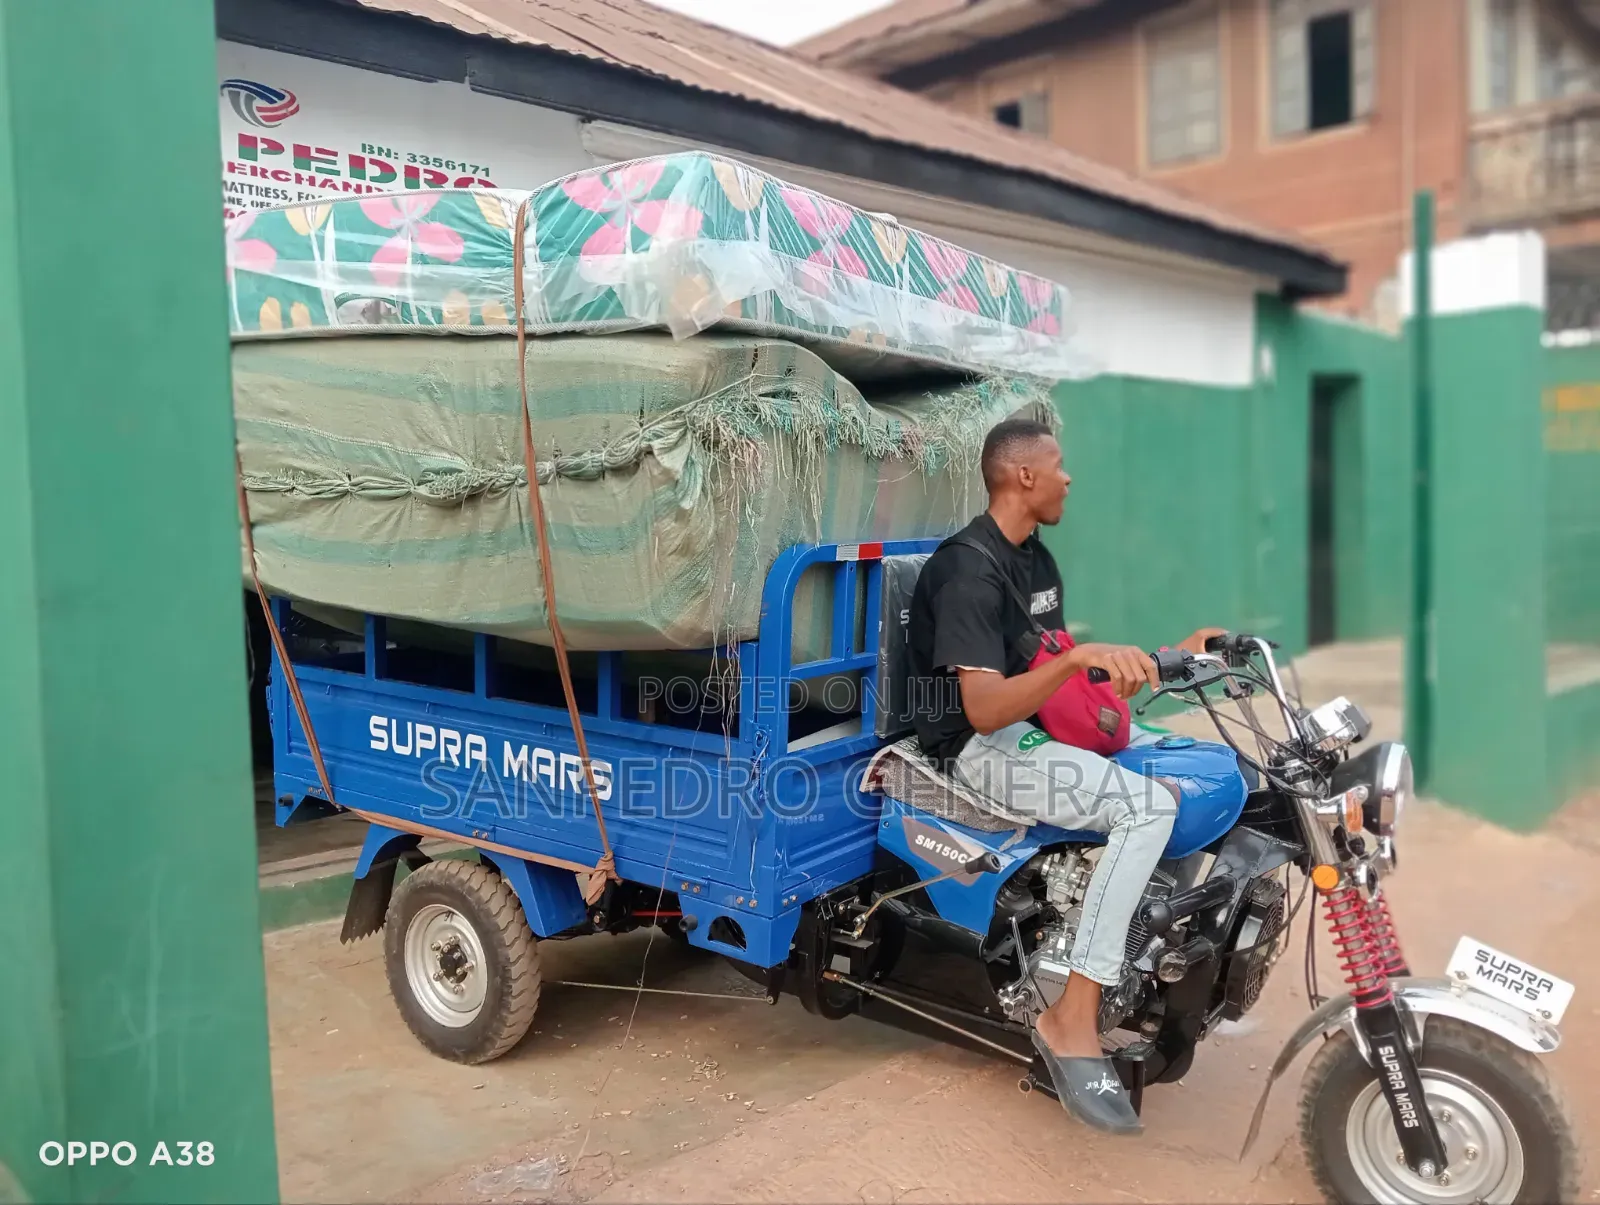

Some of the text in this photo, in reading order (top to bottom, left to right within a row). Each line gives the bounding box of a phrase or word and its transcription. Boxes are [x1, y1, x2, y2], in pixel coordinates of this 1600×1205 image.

[361, 142, 490, 178] BN: 3356171
[369, 715, 613, 801] SUPRA MARS
[1475, 949, 1554, 993] SUPRA
[1476, 964, 1540, 1001] MARS
[1378, 1045, 1419, 1128] SUPRA MARS
